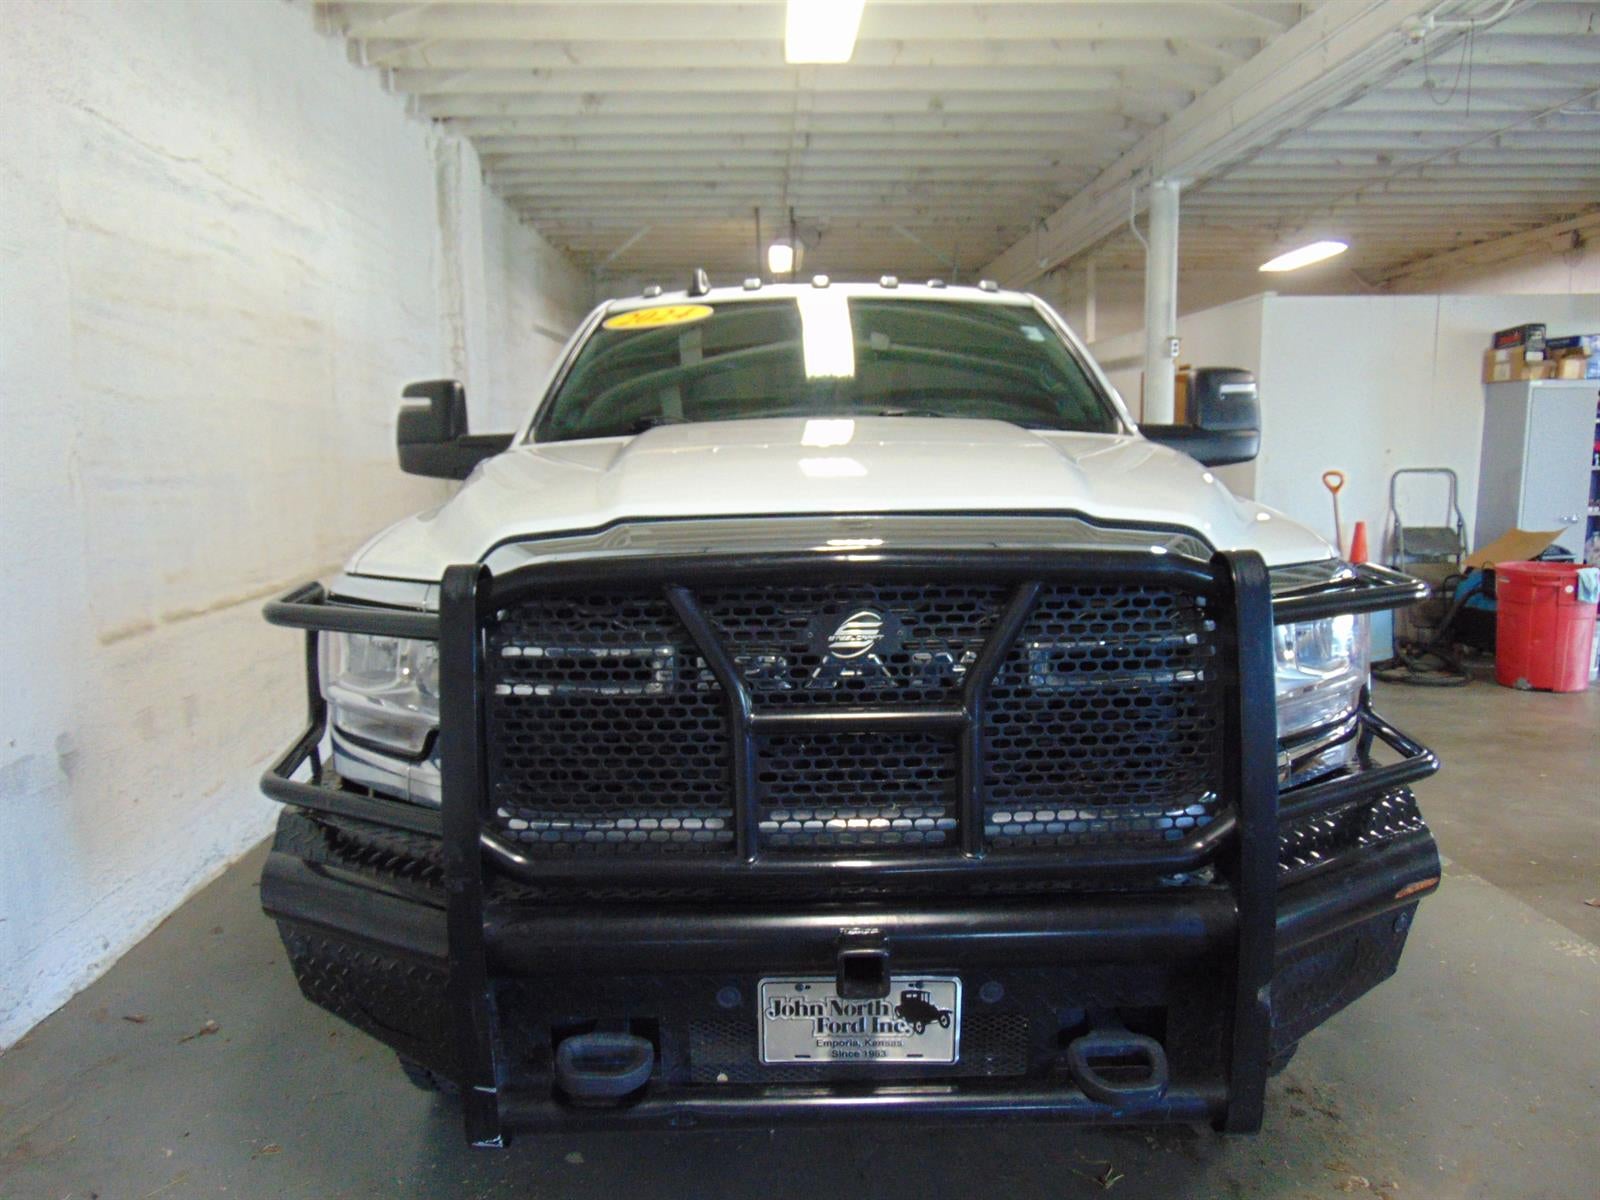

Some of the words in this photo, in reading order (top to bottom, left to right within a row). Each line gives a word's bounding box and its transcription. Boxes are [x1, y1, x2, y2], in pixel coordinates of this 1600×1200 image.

[767, 998, 824, 1018] John
[829, 998, 890, 1017] North
[816, 1017, 865, 1034] Ford
[816, 1038, 861, 1048] Emporia,
[864, 1038, 903, 1047] Kansas
[831, 1049, 860, 1058] Since
